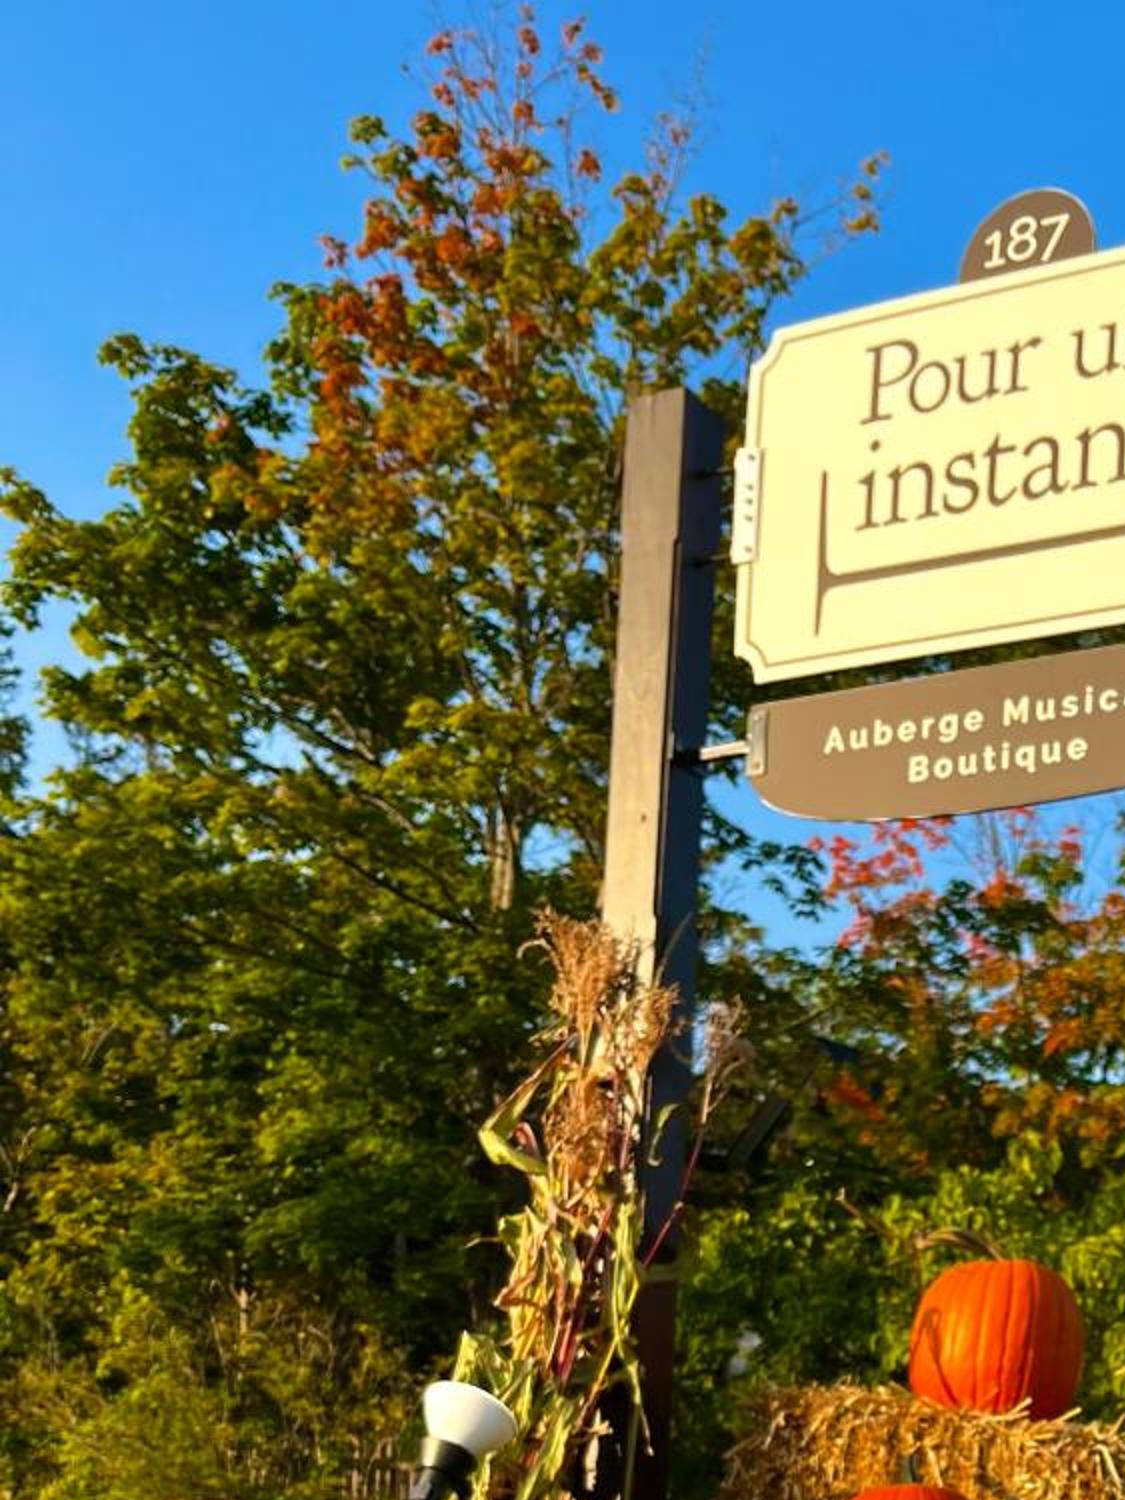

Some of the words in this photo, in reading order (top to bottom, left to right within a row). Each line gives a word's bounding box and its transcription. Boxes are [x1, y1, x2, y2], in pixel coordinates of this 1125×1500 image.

[983, 213, 1070, 269] 187
[860, 336, 1043, 427] Pour
[823, 707, 984, 755] Auberge
[908, 737, 1089, 784] Boutique
